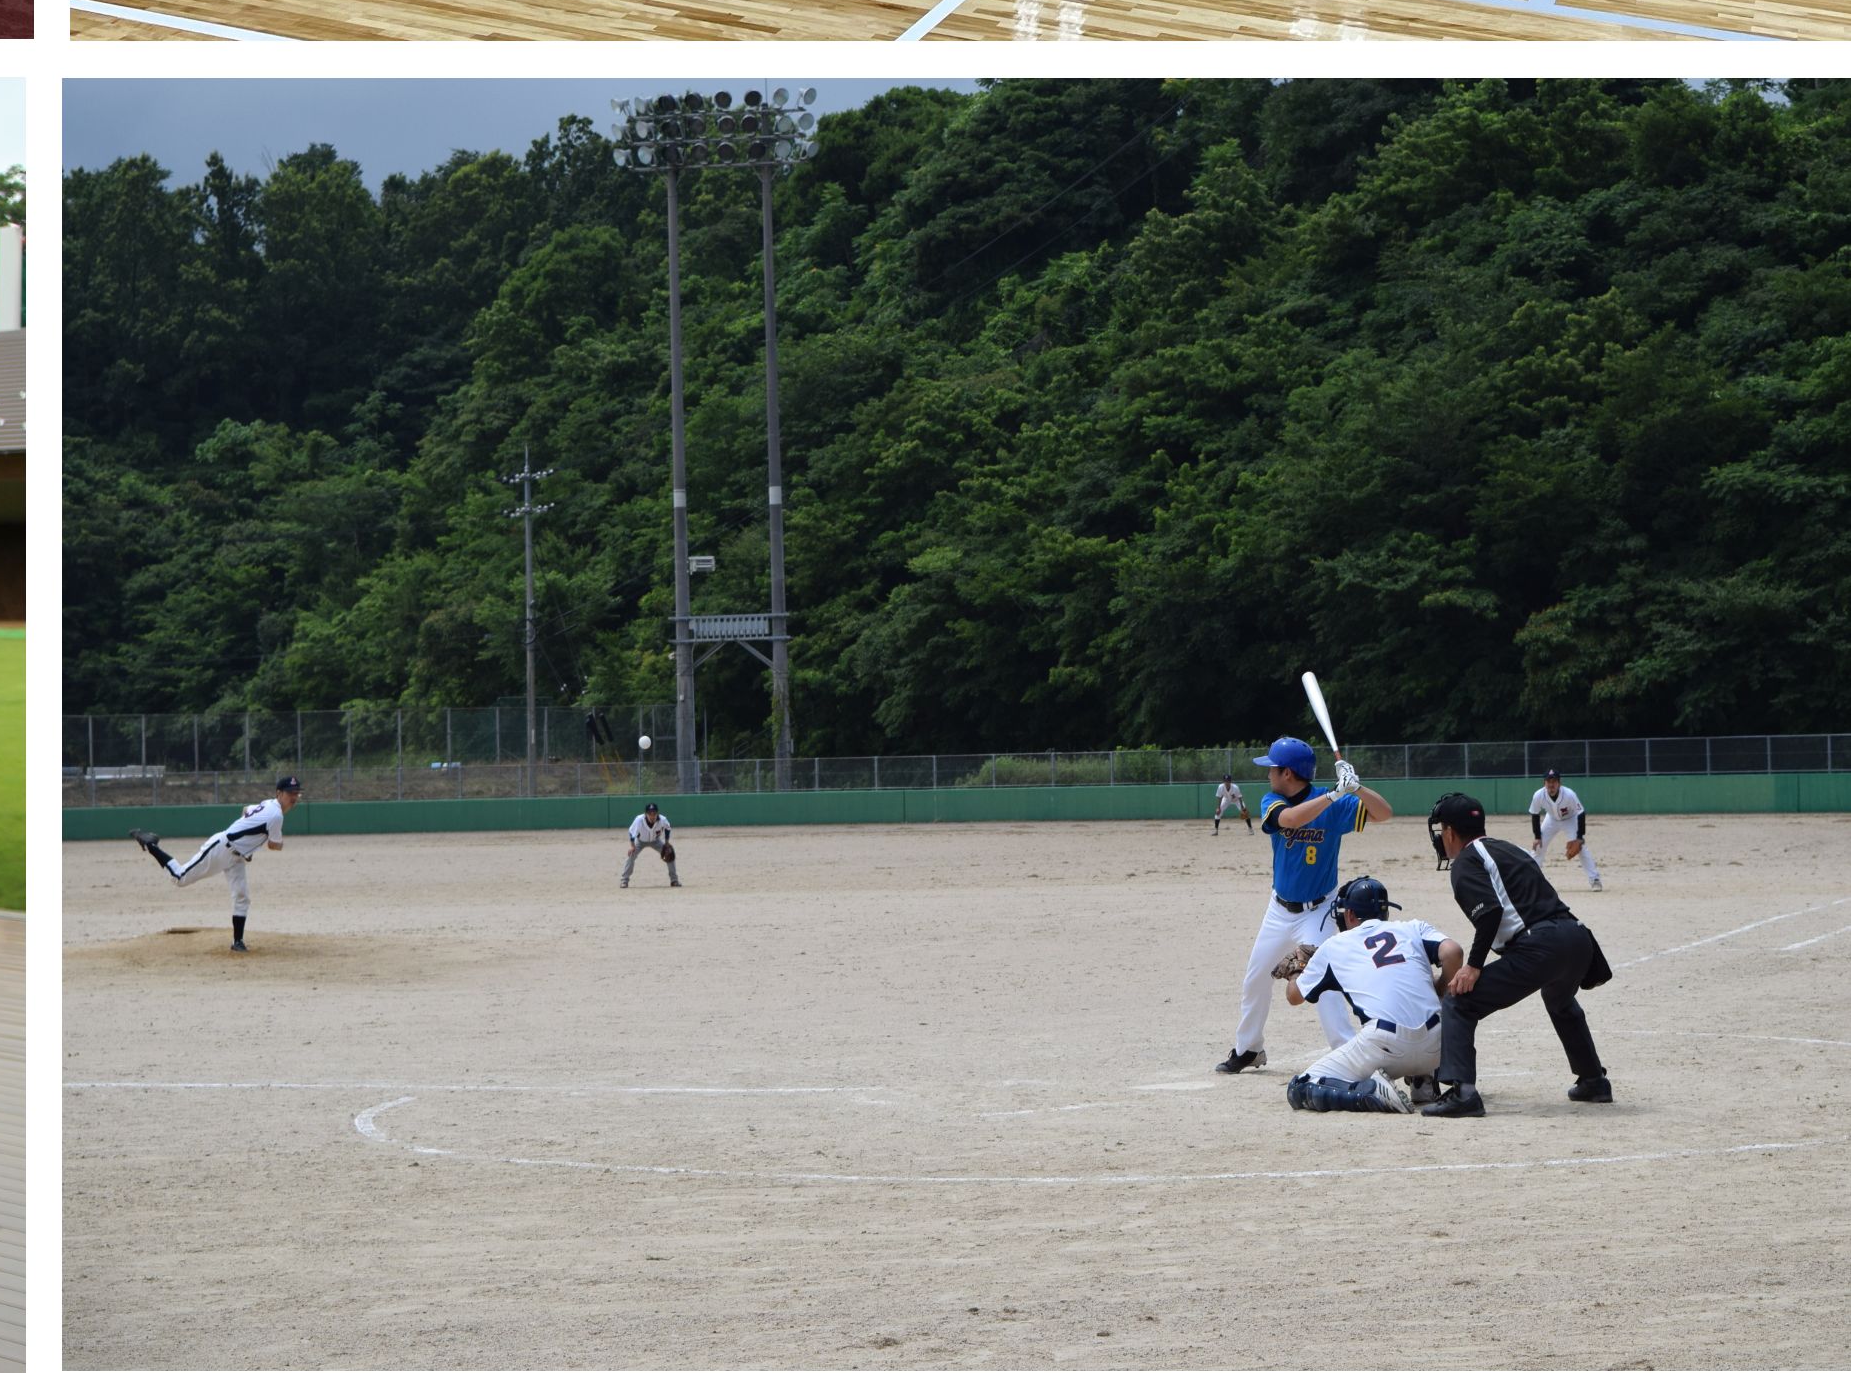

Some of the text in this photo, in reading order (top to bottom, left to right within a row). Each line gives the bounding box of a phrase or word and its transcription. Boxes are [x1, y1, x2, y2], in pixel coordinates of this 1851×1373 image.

[1280, 827, 1325, 849] oyama
[1305, 845, 1317, 865] 8
[1364, 931, 1406, 969] 2
